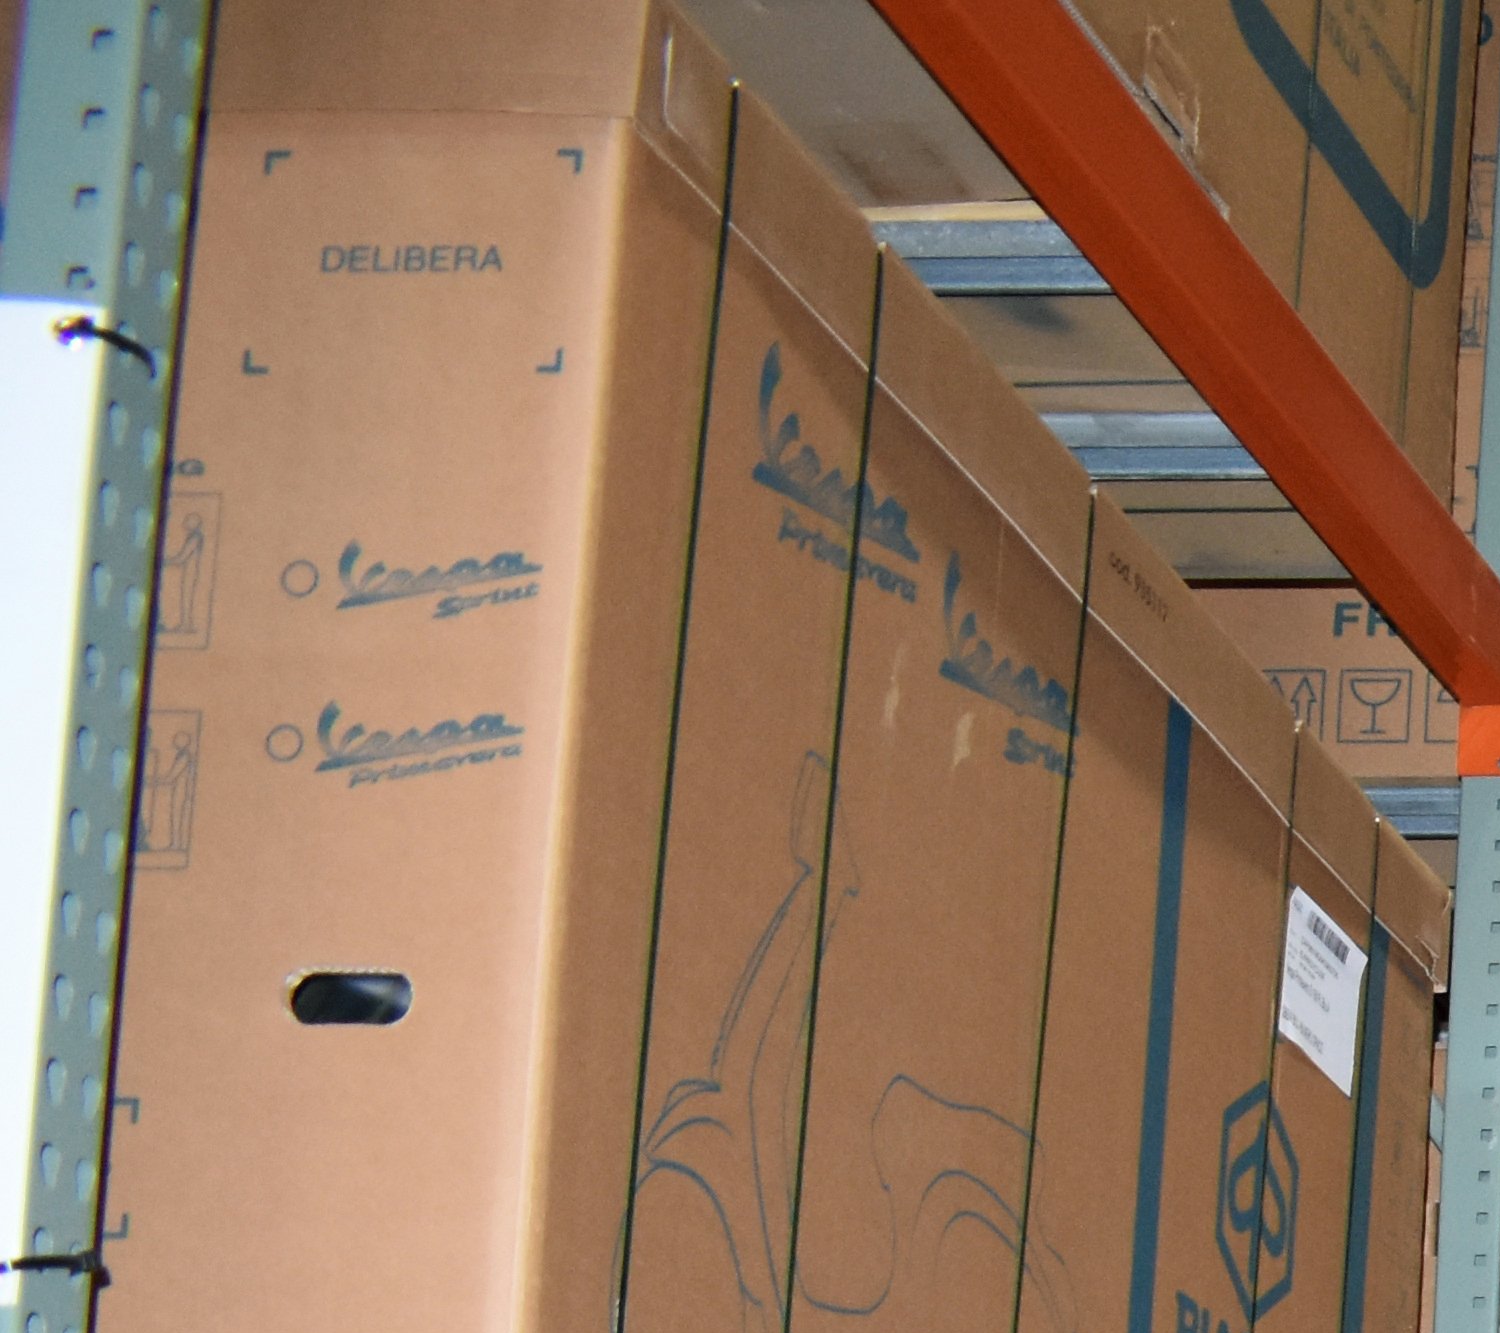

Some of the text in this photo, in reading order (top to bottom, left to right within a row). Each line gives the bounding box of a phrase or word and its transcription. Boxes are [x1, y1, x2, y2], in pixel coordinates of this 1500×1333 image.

[320, 245, 503, 273] DELIBERA
[335, 540, 544, 611] Vespa
[314, 702, 526, 773] Vespa
